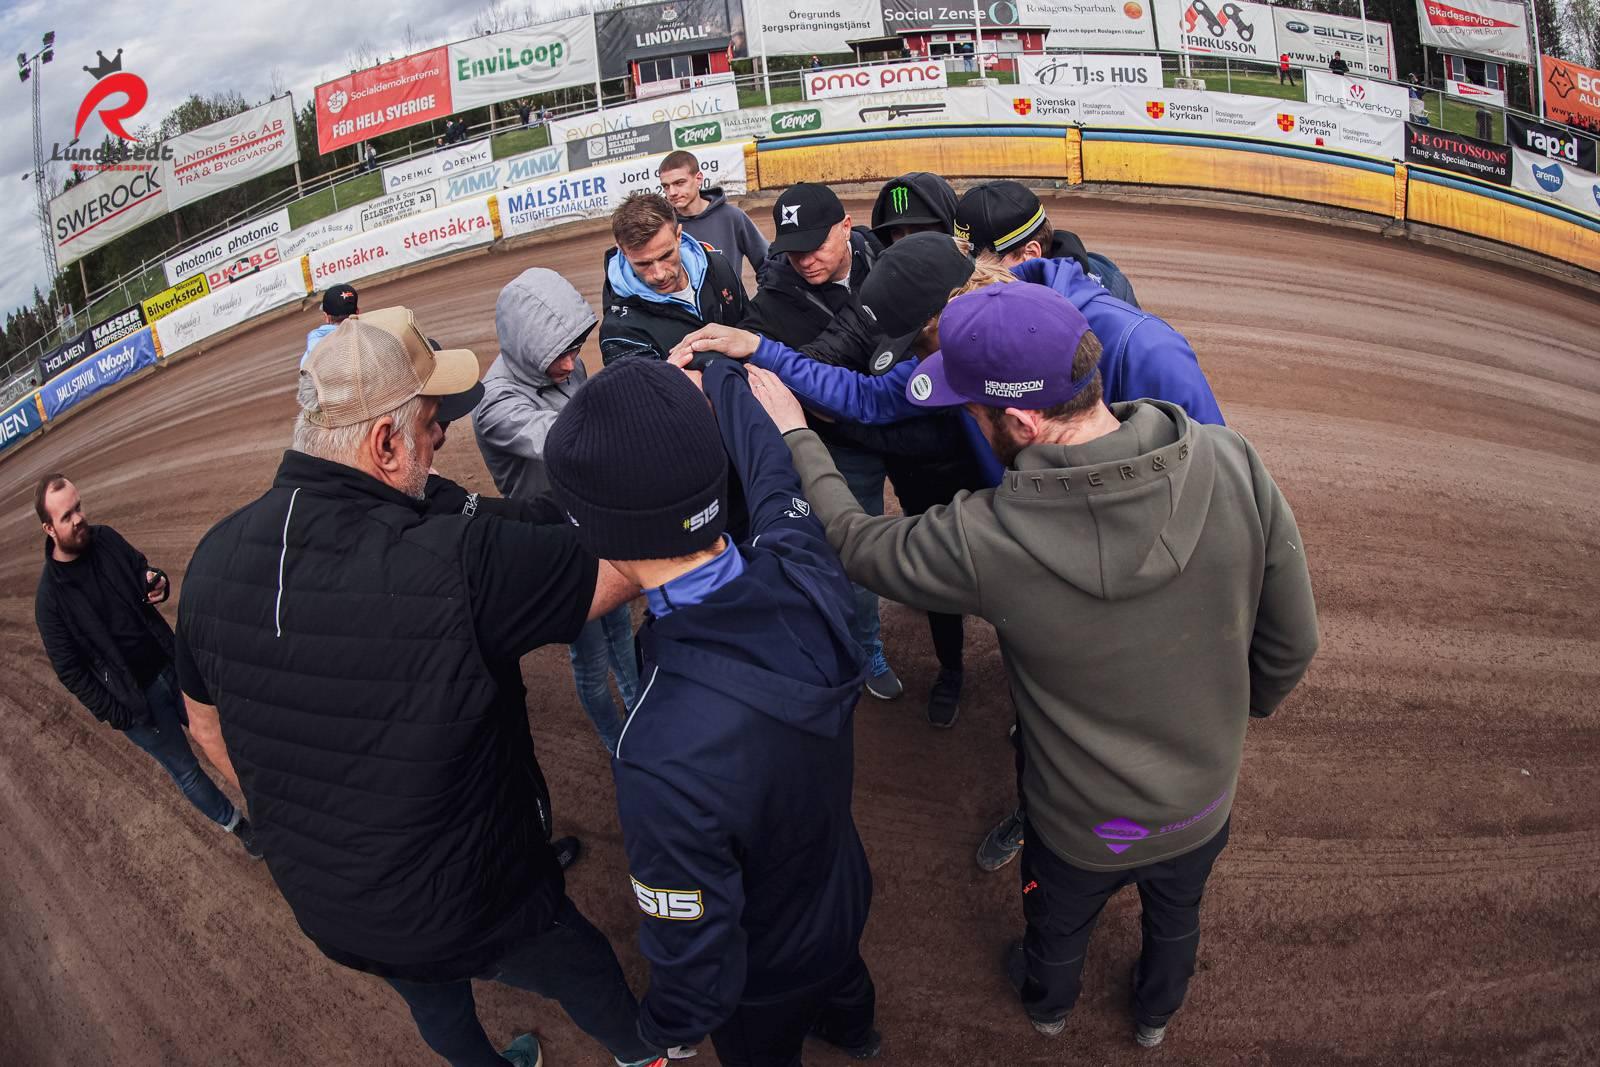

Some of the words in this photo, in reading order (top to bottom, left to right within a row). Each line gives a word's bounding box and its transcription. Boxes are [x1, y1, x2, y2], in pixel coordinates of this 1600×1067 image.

[789, 10, 840, 20] Öregrunds
[884, 8, 934, 22] Social
[1026, 4, 1072, 14] Roslagens
[1074, 4, 1116, 14] Sparbank
[1429, 6, 1494, 26] Skadeservice
[762, 21, 871, 33] Bergsprängningstjänst
[1180, 34, 1256, 54] MARKUSSON
[457, 42, 563, 81] EnviLoop
[351, 68, 440, 100] Socialdemokraterna
[811, 72, 870, 96] pmc
[880, 66, 940, 88] pmc
[1110, 67, 1148, 84] HUS
[652, 96, 723, 122] evolvit
[1036, 98, 1076, 106] Svenska
[1036, 106, 1070, 116] kyrkan
[1169, 102, 1209, 112] Svenska
[1315, 91, 1402, 118] industriverktyg
[332, 120, 354, 138] FÖR
[356, 110, 385, 130] HELA
[386, 94, 436, 121] SVERIGE
[724, 115, 768, 127] HALLSTAVIK
[776, 112, 816, 129] tempo
[1169, 110, 1202, 120] kyrkan
[1299, 117, 1336, 129] Svenska
[566, 114, 632, 139] evolvit
[678, 125, 718, 142] tempo
[1299, 125, 1331, 136] kyrkan
[174, 142, 226, 169] LINDRIS
[261, 119, 283, 136] AB
[1411, 131, 1430, 146] J-E
[1433, 137, 1506, 164] OTTOSSONS
[202, 167, 211, 176] &
[214, 140, 284, 172] BYGGVAROR
[700, 160, 719, 172] og
[1410, 146, 1432, 158] Tung-
[1433, 152, 1440, 160] &
[1442, 154, 1494, 173] Specialtransport
[1494, 167, 1506, 176] AB
[620, 168, 650, 184] Jord
[1536, 170, 1560, 184] arema
[56, 166, 161, 240] SWEROCK
[368, 197, 394, 210] Kenneth
[402, 190, 416, 199] Son
[508, 176, 607, 214] MÅLSÄTER
[364, 198, 416, 221] BILSERVICE
[420, 194, 432, 203] AB
[510, 196, 609, 226] FASTIGHETSMÄKLARE
[228, 222, 279, 253] photonic
[306, 230, 320, 238] Taxi
[316, 245, 389, 278] stensåkra.
[404, 215, 490, 249] stensåkra.
[175, 246, 222, 277] photonic
[147, 282, 204, 317] Bilverkstad
[92, 309, 140, 341] KAESER
[94, 320, 142, 350] KOMPRESSORER
[46, 341, 86, 373] HOLMEN
[98, 346, 134, 373] Woody
[56, 368, 96, 402] HALLSTAVIK
[984, 379, 1044, 391] HENDERSON
[985, 387, 1023, 398] RACING
[1152, 455, 1167, 472] &
